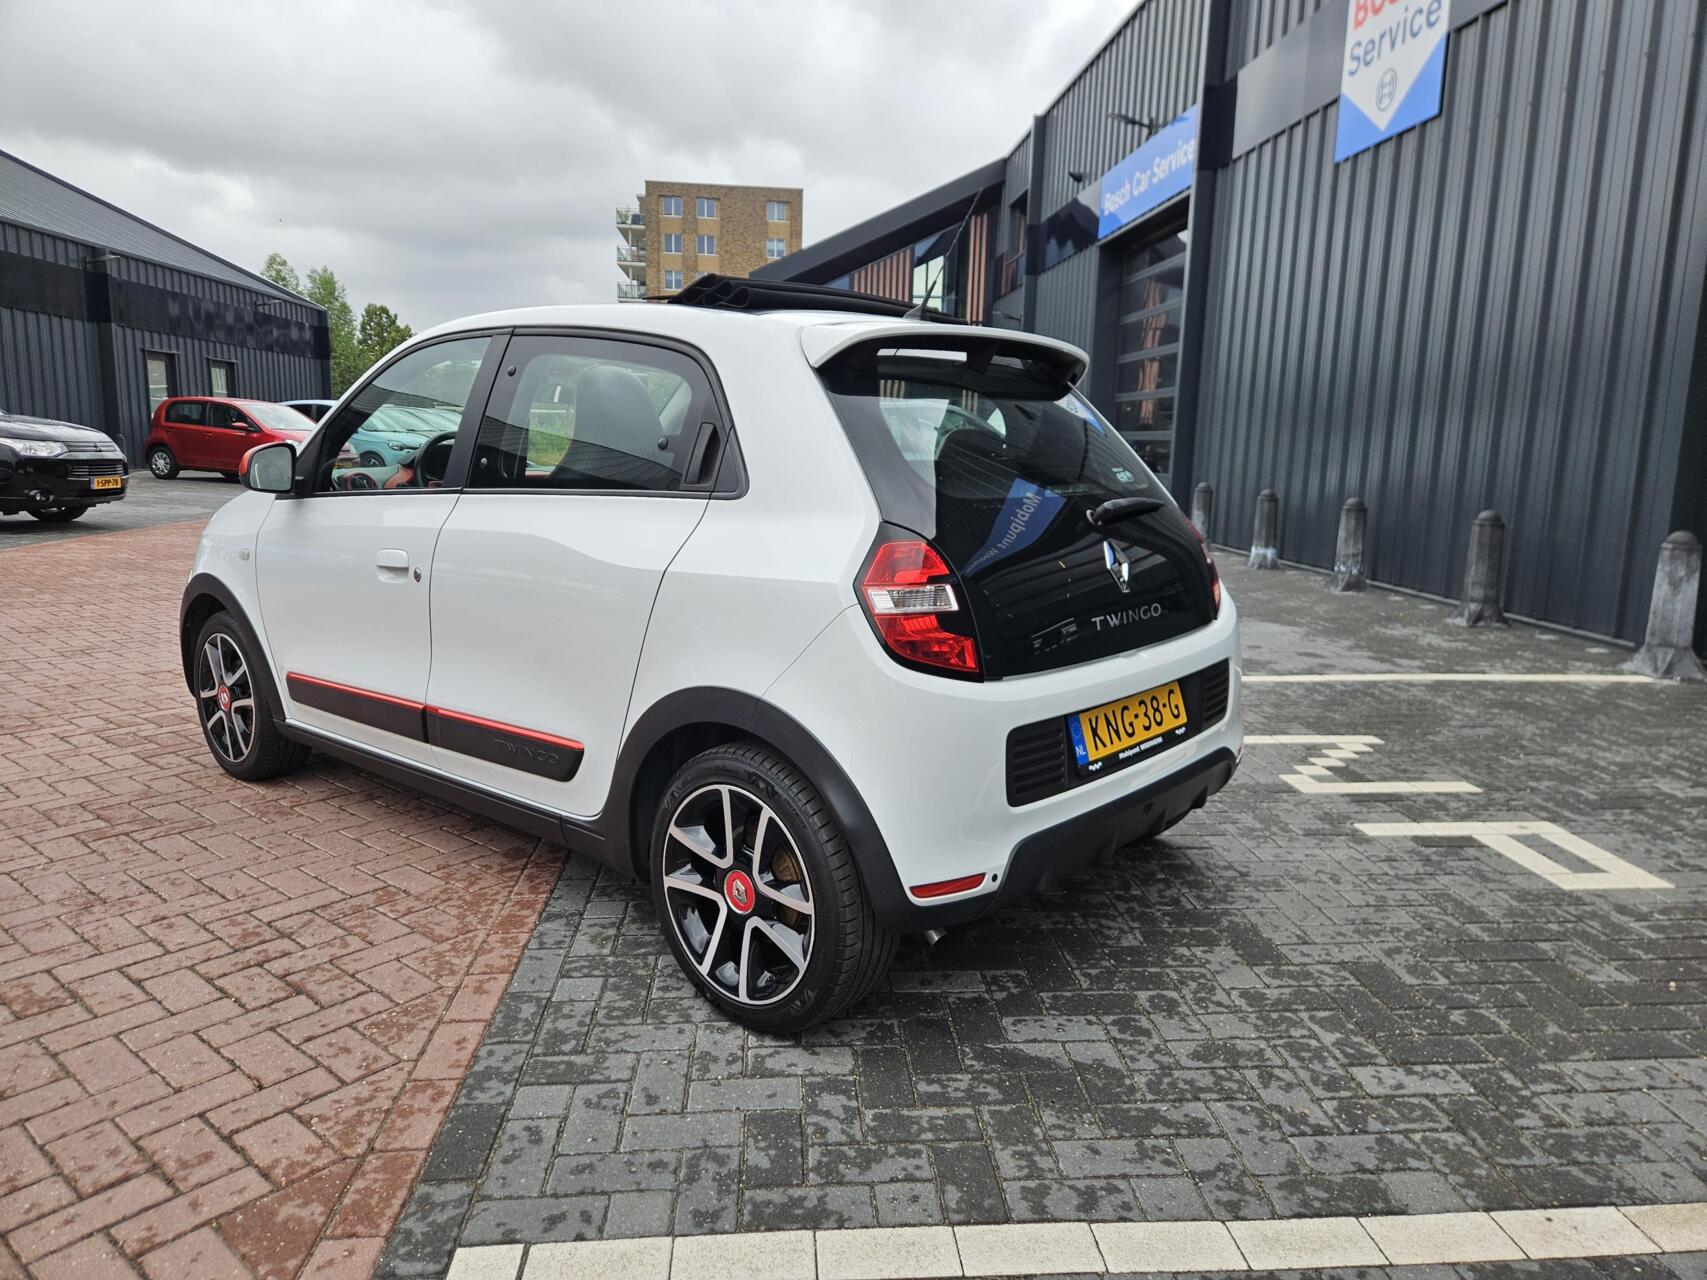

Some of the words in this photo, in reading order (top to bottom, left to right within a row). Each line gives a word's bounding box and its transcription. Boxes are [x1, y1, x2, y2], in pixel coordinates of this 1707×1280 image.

[1347, 0, 1443, 77] Service
[1103, 177, 1131, 217] Bosch
[1132, 167, 1152, 197] Car
[1151, 139, 1196, 185] Service
[1091, 602, 1162, 632] TWINGO
[1075, 744, 1087, 757] NL
[1087, 687, 1182, 752] KNG-38-G
